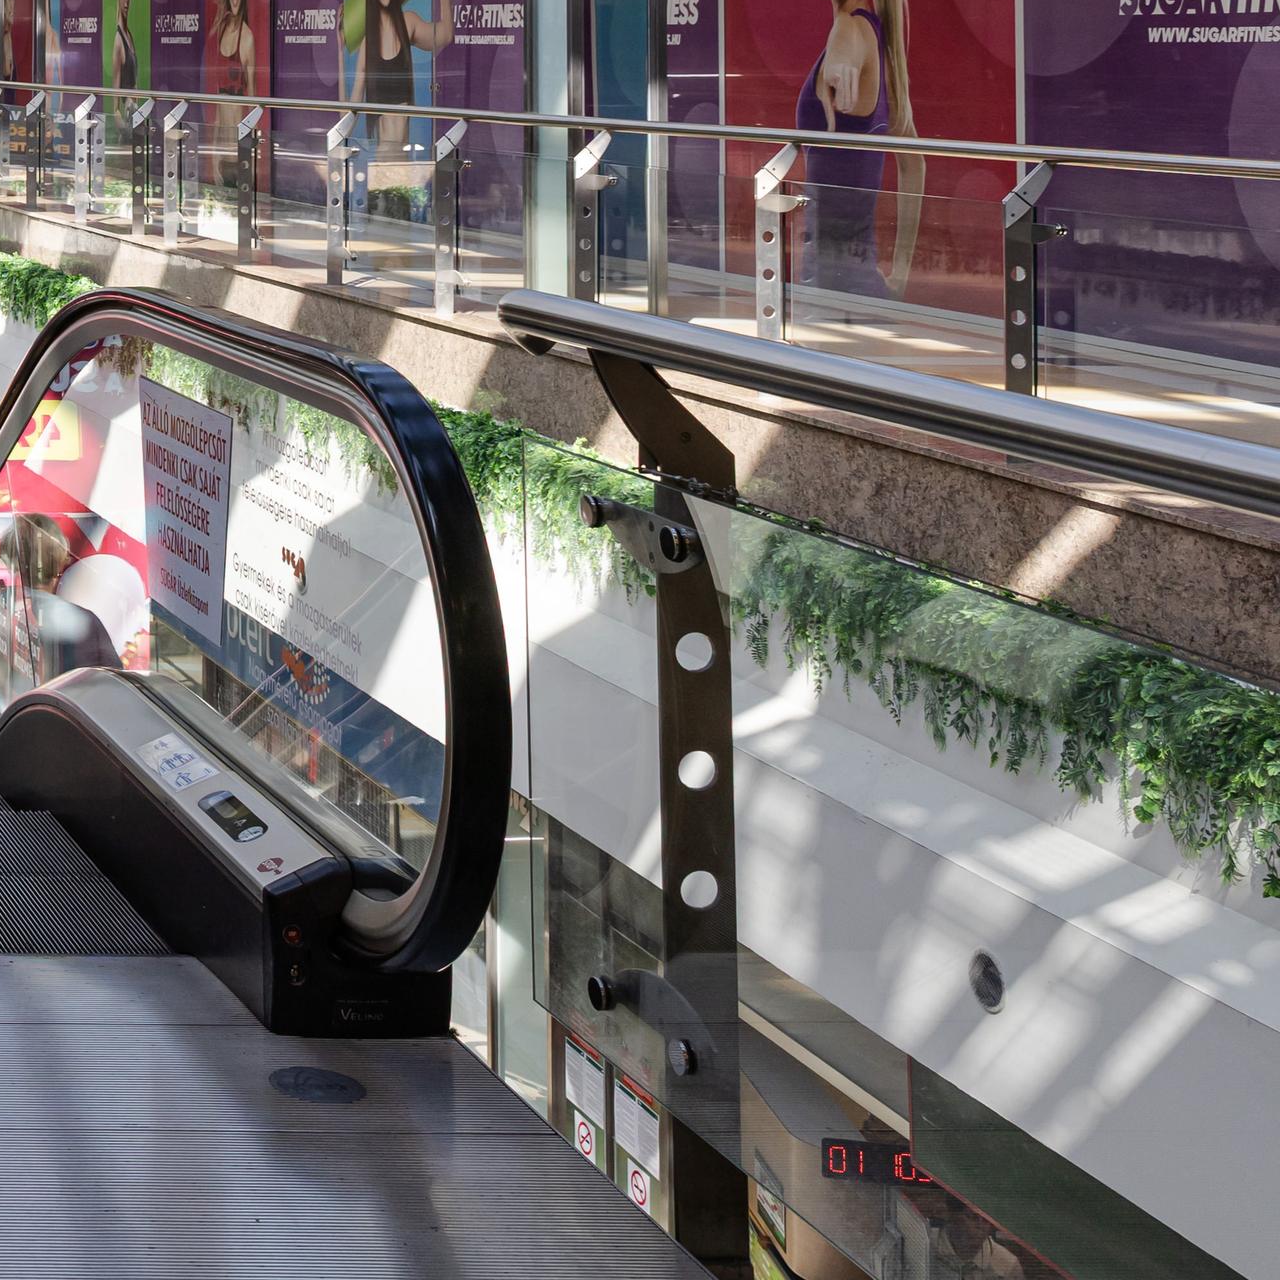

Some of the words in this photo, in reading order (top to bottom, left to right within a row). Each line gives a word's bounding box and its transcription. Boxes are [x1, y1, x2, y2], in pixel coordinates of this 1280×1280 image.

[152, 398, 169, 436] ÁLLÓ
[170, 413, 227, 466] MOZGÓLÉPCSŐT
[146, 439, 179, 479] MINDENKI
[180, 457, 198, 490] CSAK
[199, 464, 221, 503] SAJÁT
[157, 519, 210, 577] HASZNÁLHATJA
